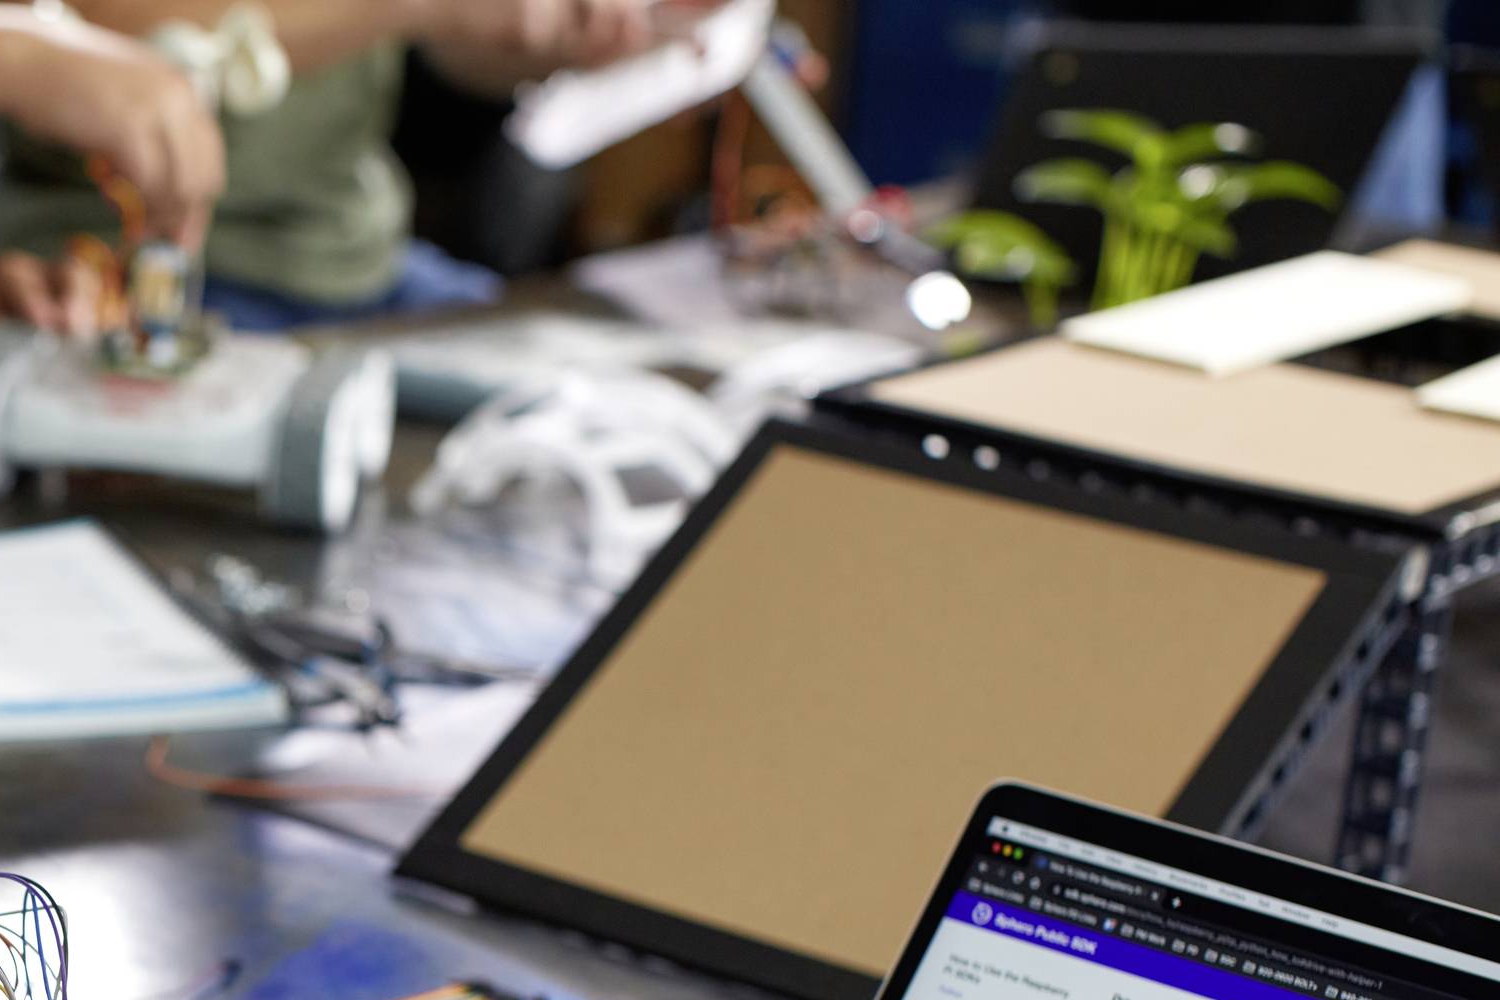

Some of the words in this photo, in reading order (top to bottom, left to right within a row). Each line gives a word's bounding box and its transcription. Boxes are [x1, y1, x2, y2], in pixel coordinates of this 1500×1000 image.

[994, 911, 1034, 938] Sphero
[1035, 924, 1070, 948] Public
[1070, 934, 1098, 955] SDK
